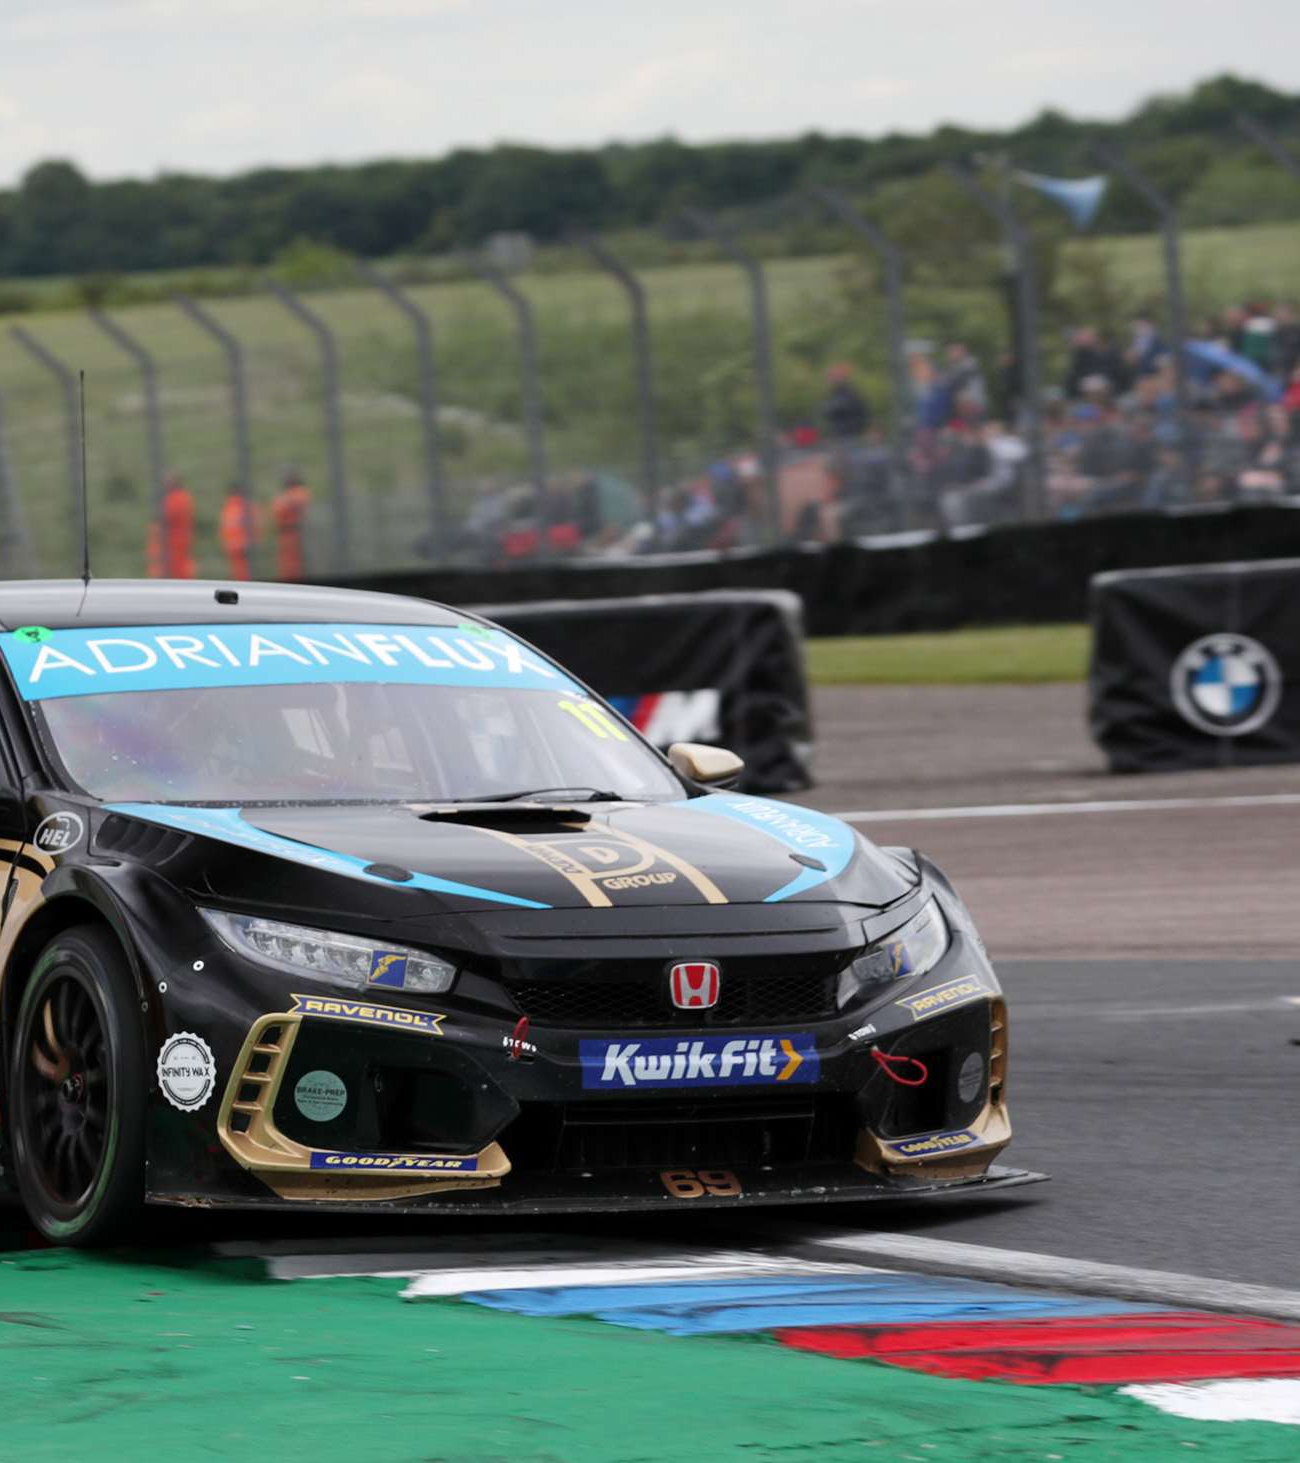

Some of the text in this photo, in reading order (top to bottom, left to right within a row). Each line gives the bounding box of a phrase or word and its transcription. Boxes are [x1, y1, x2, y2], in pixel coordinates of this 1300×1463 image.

[29, 632, 554, 683] ADRIANFLUX
[558, 700, 629, 742] 11
[39, 827, 72, 848] HEL
[602, 872, 677, 890] GROUP
[911, 984, 980, 1011] RAVENOL
[306, 1001, 429, 1026] RAVENOL
[161, 1066, 210, 1077] INFINITY WAX
[601, 1040, 778, 1085] Kwik Fit
[325, 1156, 462, 1168] GOODYEAR
[660, 1170, 742, 1198] 69
